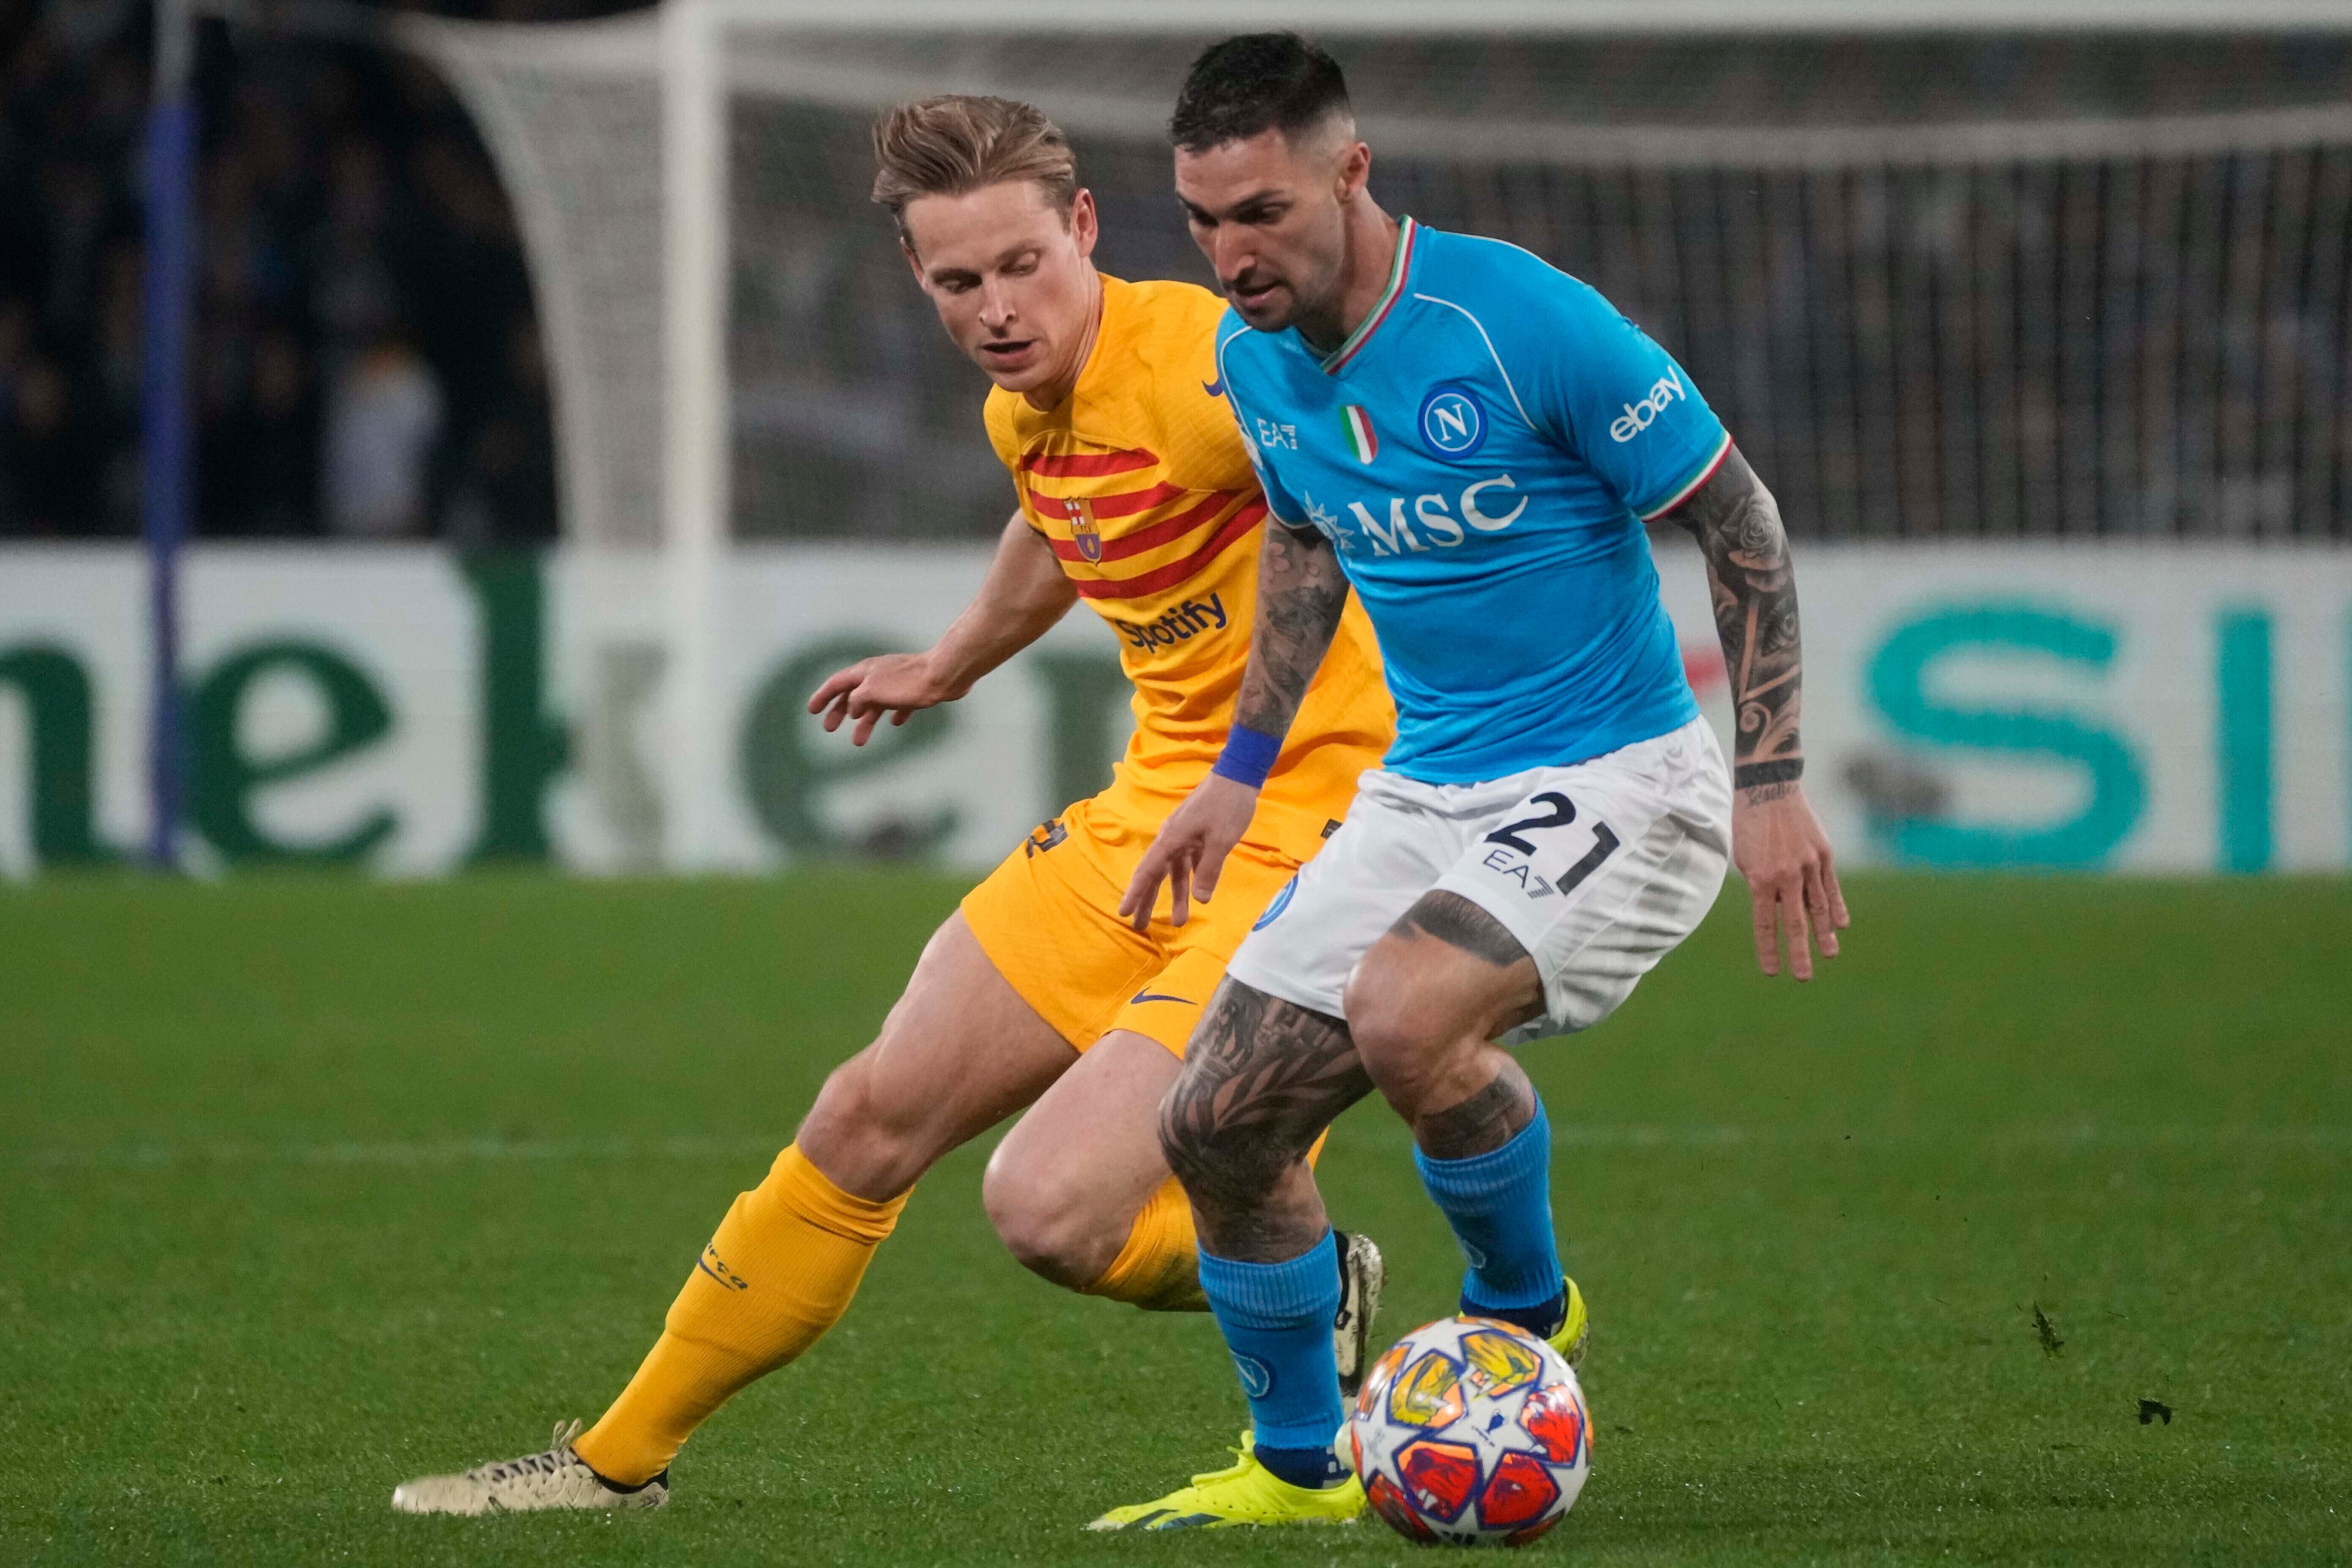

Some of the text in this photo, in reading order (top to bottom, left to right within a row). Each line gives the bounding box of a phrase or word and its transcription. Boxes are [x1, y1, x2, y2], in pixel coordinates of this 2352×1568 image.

[1256, 417, 1298, 450] EA7
[1433, 403, 1467, 442] N
[1610, 364, 1686, 443] ebay
[1347, 473, 1529, 556] MSC
[1115, 592, 1227, 653] Spotify
[1483, 791, 1620, 897] 21
[1483, 849, 1555, 900] EA7
